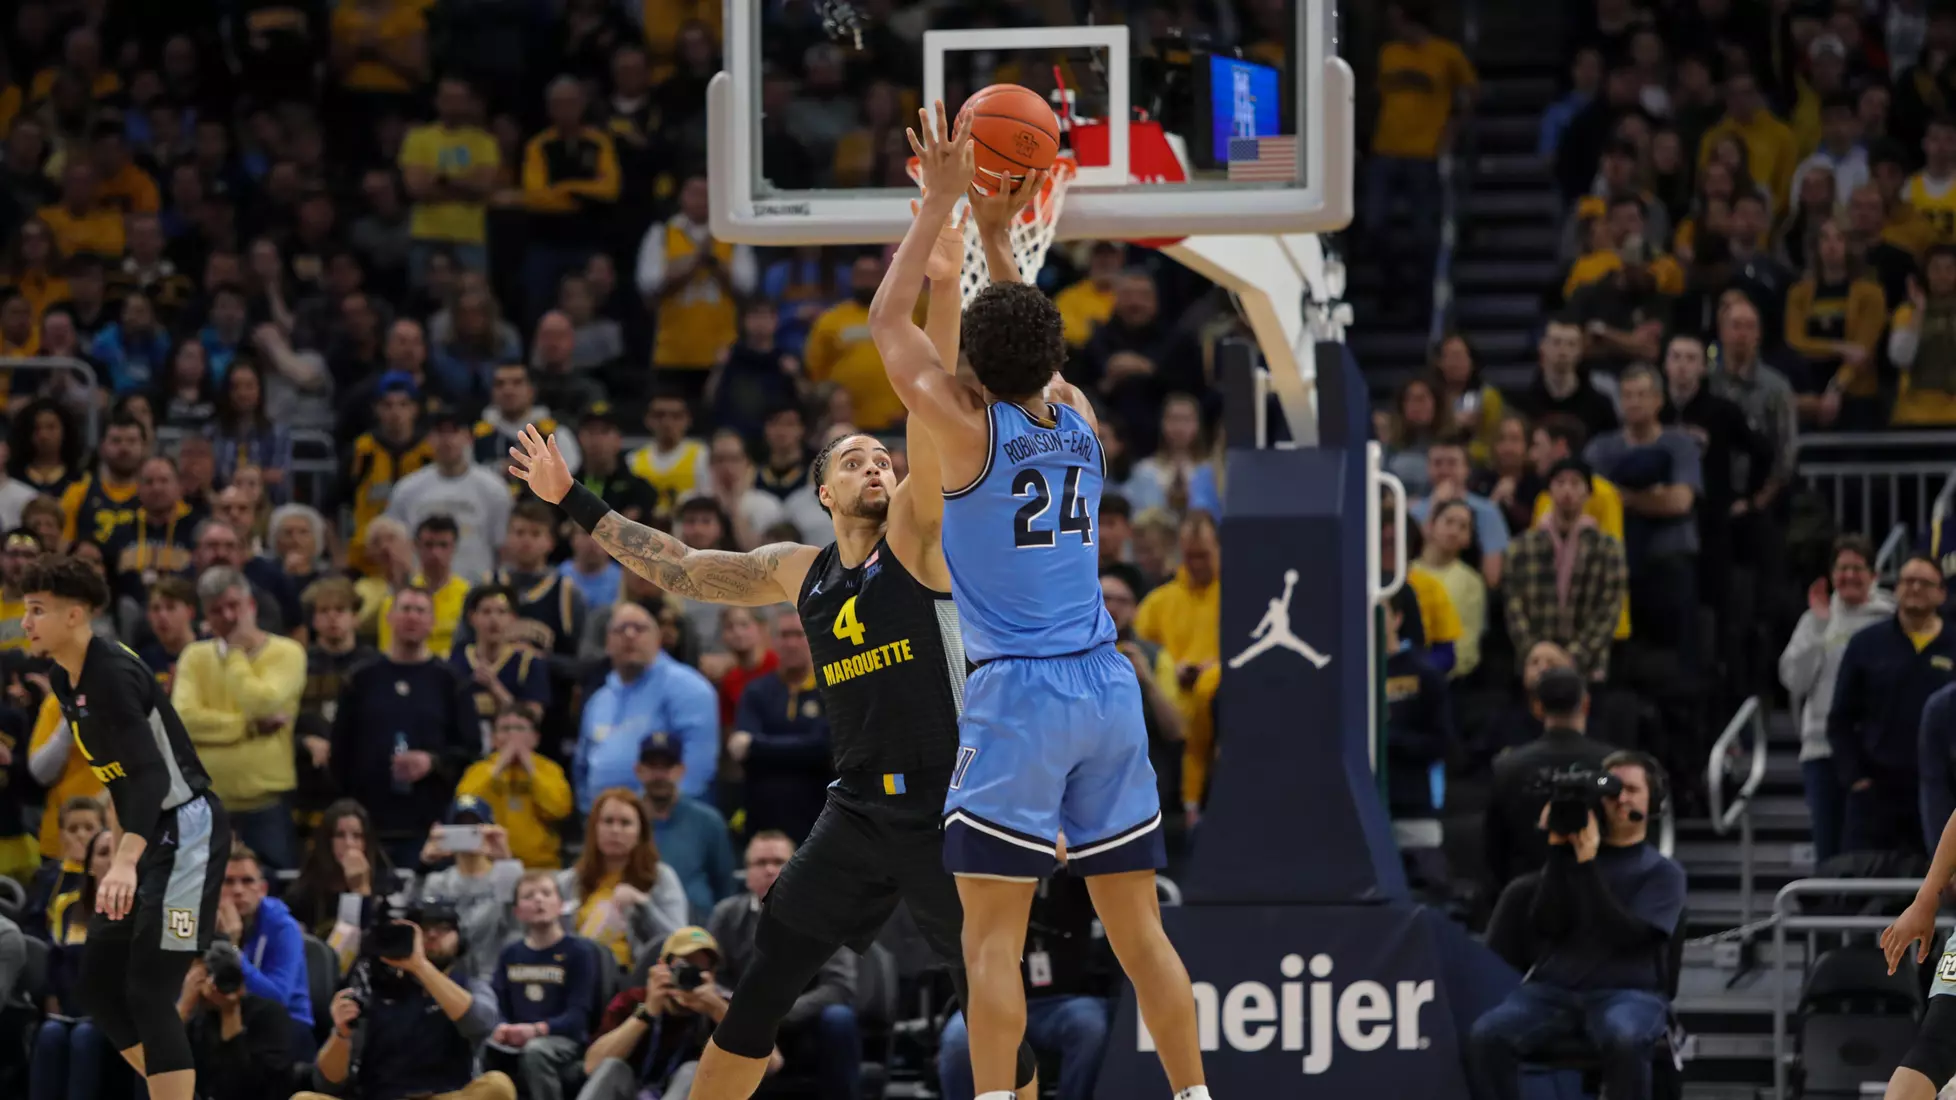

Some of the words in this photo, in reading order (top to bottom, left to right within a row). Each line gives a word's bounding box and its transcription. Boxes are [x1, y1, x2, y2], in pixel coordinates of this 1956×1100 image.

[1003, 431, 1095, 464] ROBINSON-EARL
[1011, 467, 1094, 549] 24
[832, 594, 866, 646] 4
[822, 638, 914, 686] MARQUETTE
[168, 908, 196, 938] MU
